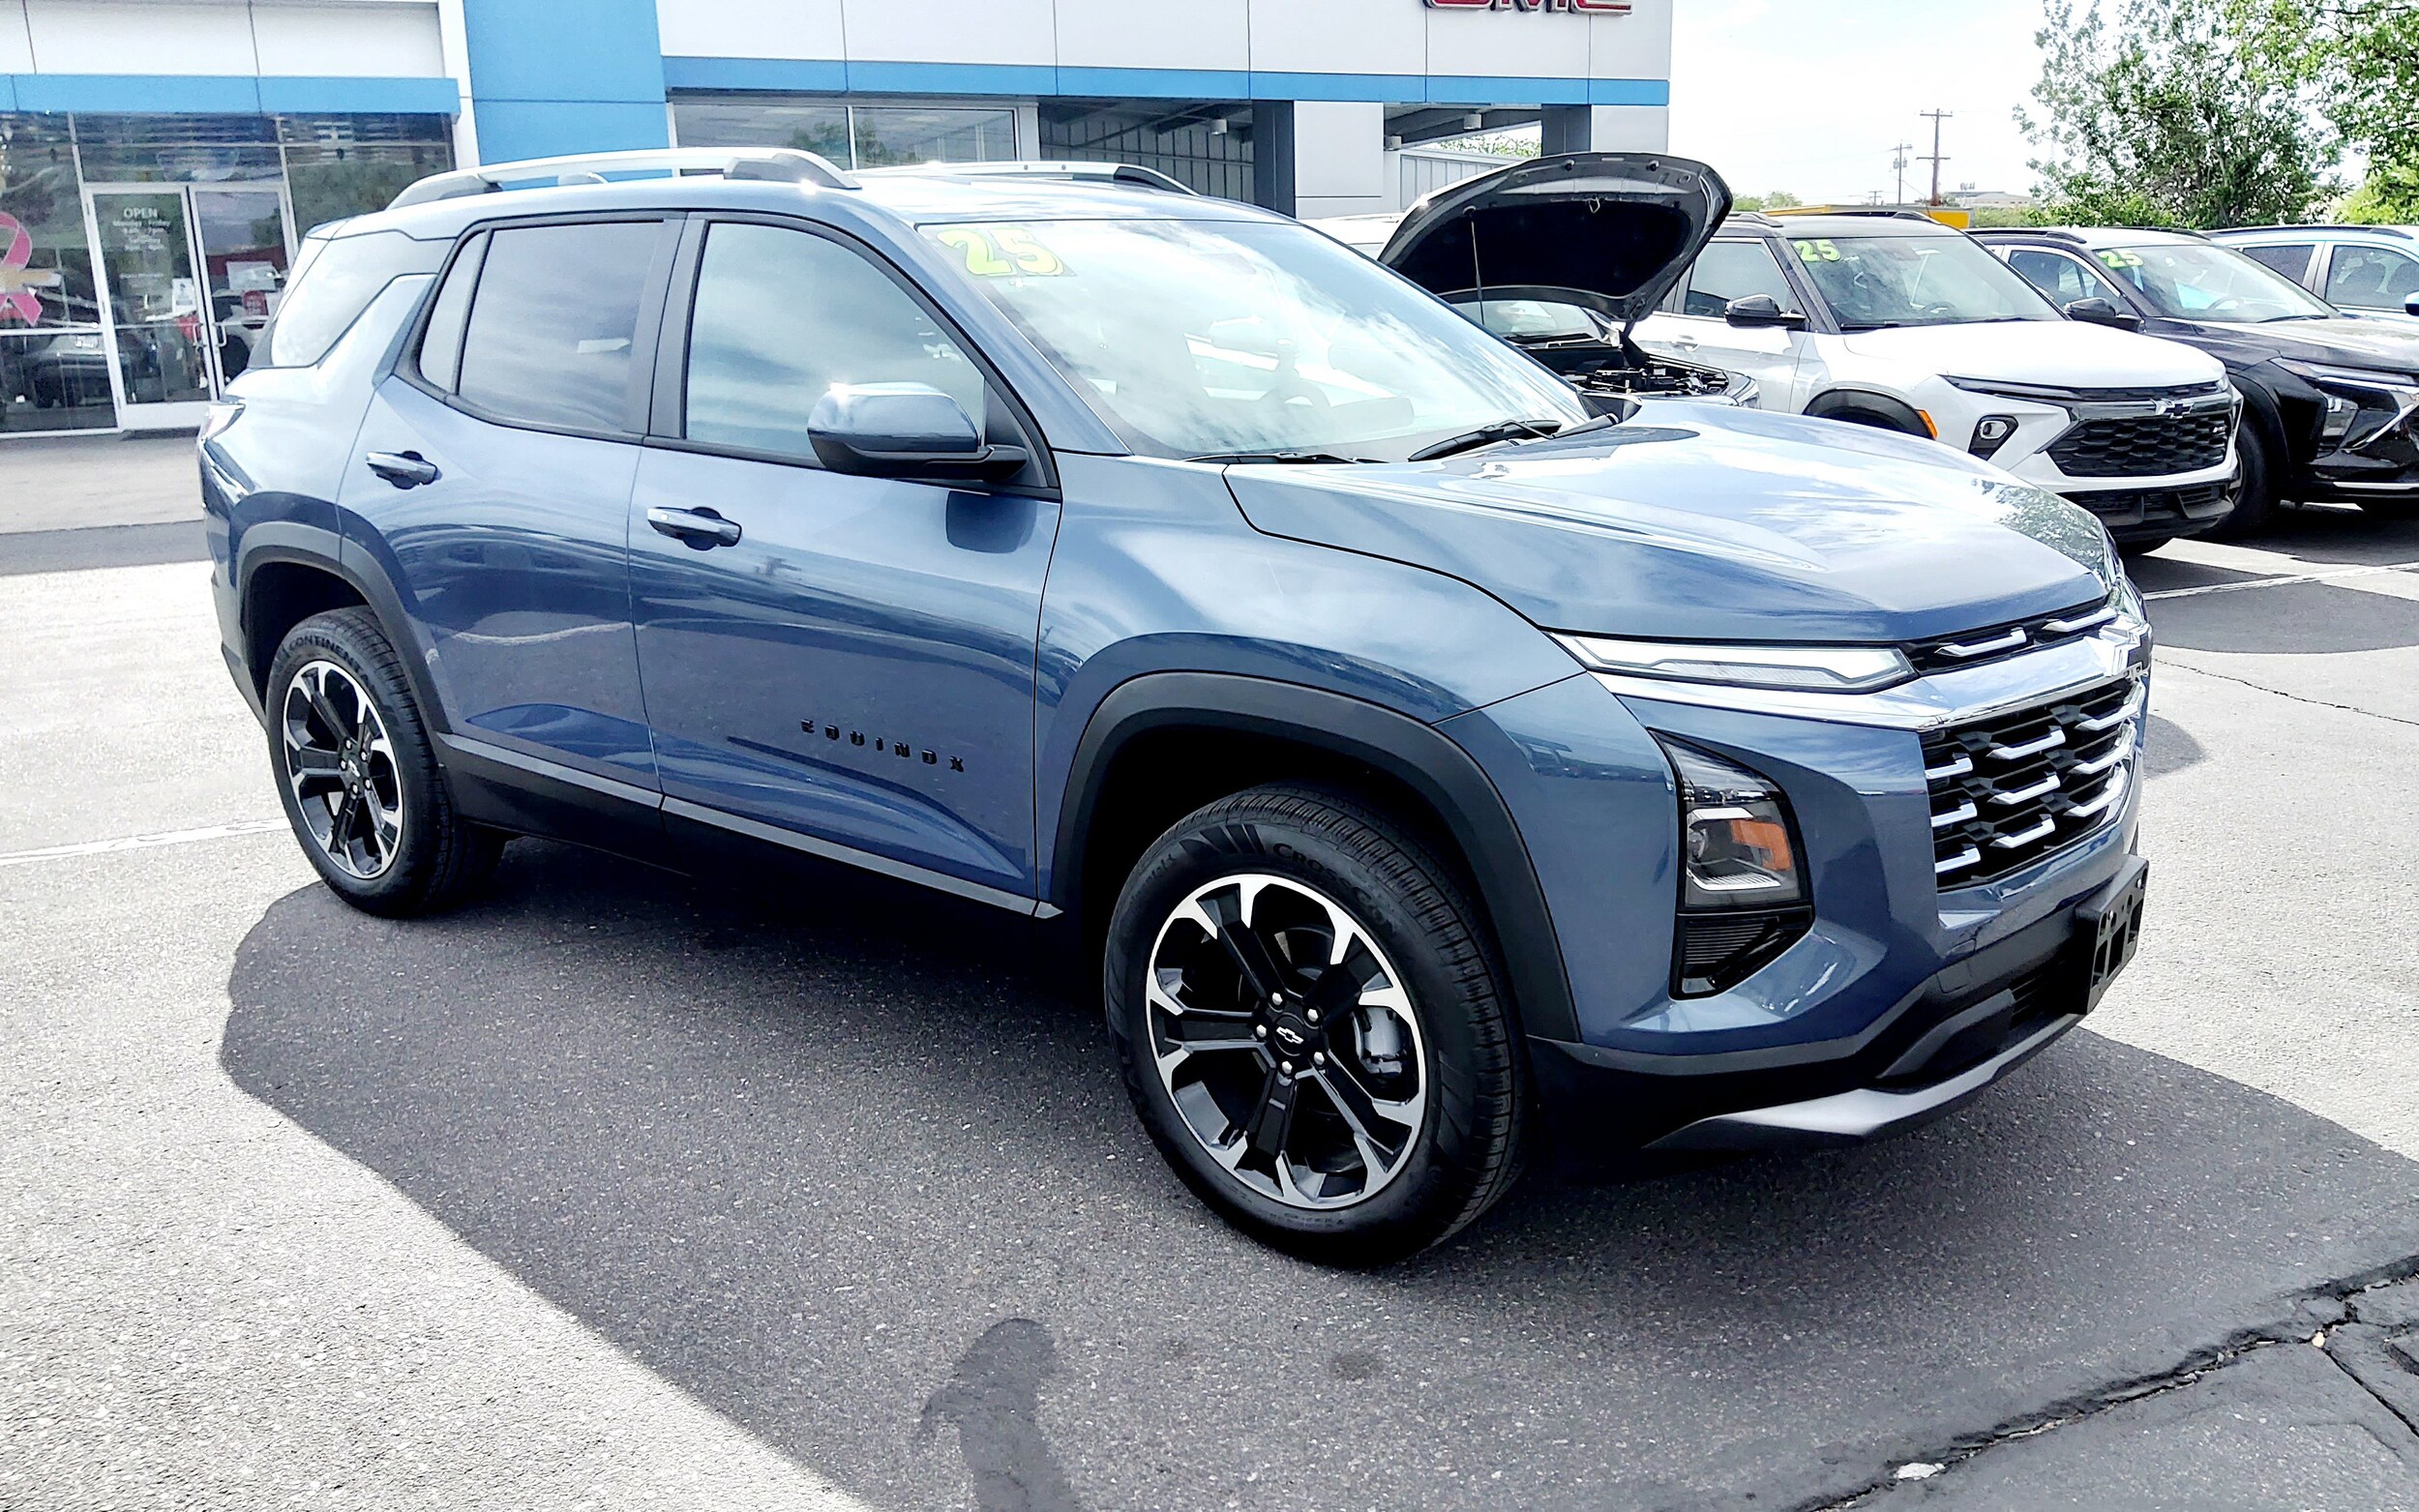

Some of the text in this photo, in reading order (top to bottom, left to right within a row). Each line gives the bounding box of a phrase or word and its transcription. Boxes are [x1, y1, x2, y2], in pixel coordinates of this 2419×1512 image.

[123, 207, 159, 219] OPEN
[937, 228, 1064, 278] 25
[1792, 239, 1841, 261] 25
[2096, 249, 2144, 268] 25
[800, 718, 965, 773] EQUINOX
